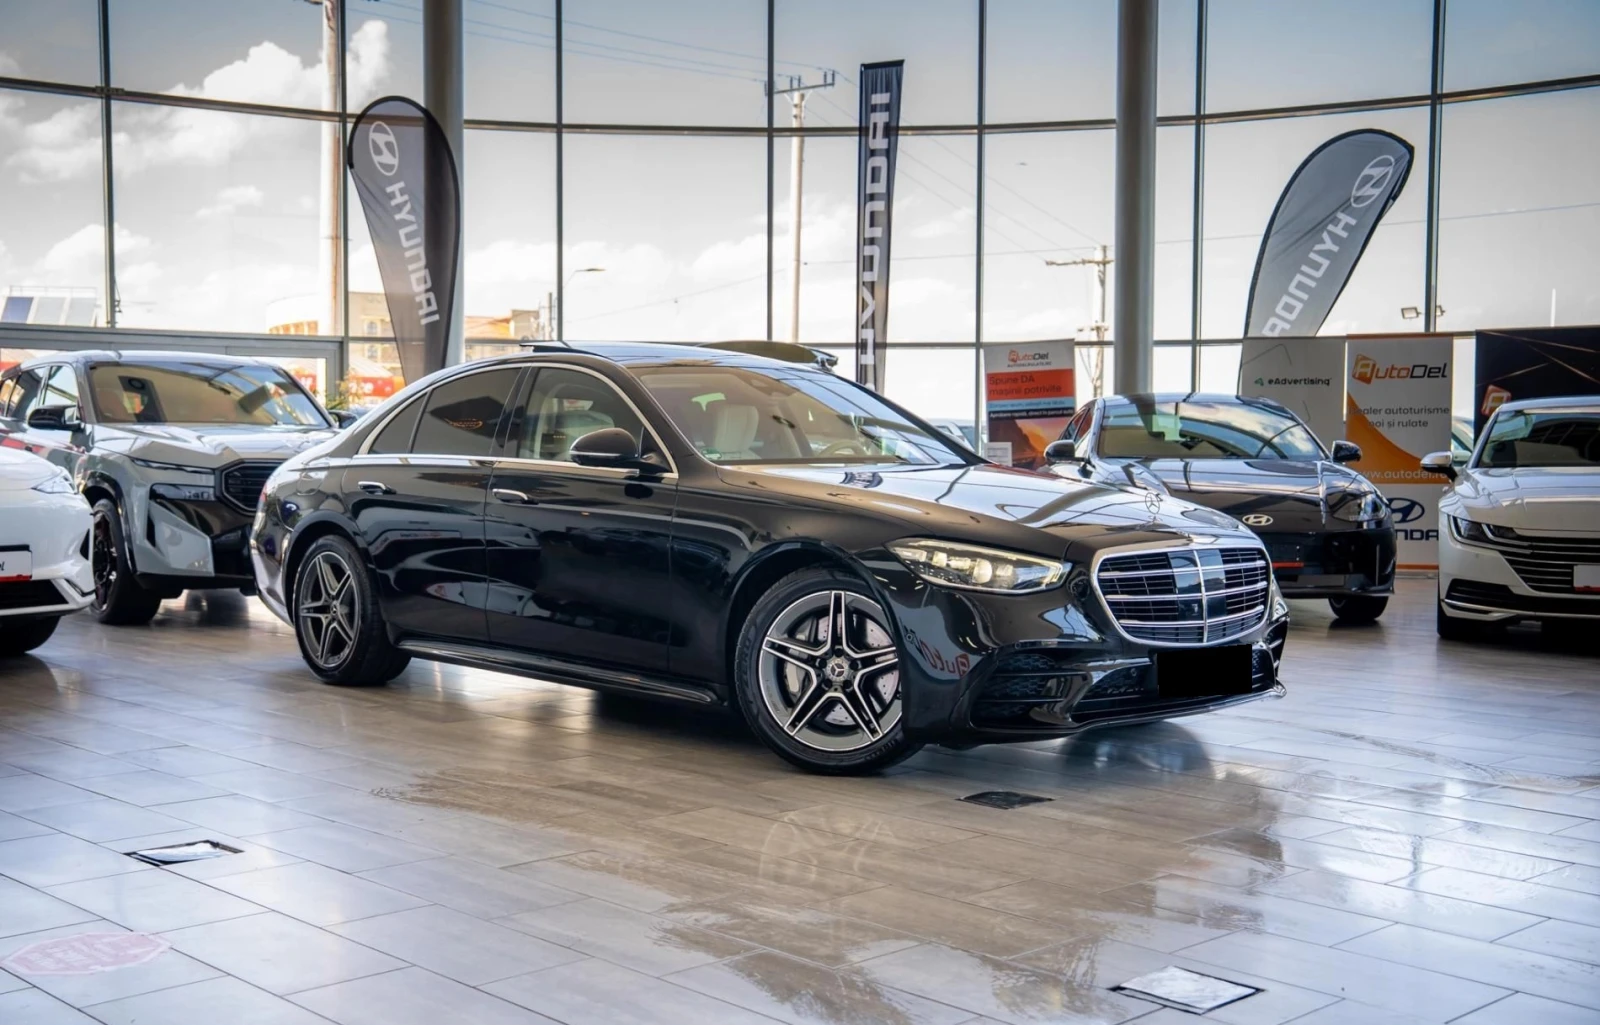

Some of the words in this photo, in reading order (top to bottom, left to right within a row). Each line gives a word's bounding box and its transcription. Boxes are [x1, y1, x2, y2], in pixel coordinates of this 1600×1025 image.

[861, 92, 891, 364] HYUNDAI
[385, 181, 440, 326] HYUNDAI
[1008, 349, 1049, 363] AutoDel
[1352, 354, 1448, 385] AutoDel
[989, 377, 1018, 386] Spune
[1020, 375, 1035, 383] DA
[1268, 377, 1330, 387] eAdvertising
[1024, 384, 1062, 394] potrivite
[1385, 406, 1449, 415] autoturisme
[1398, 419, 1428, 428] rulate
